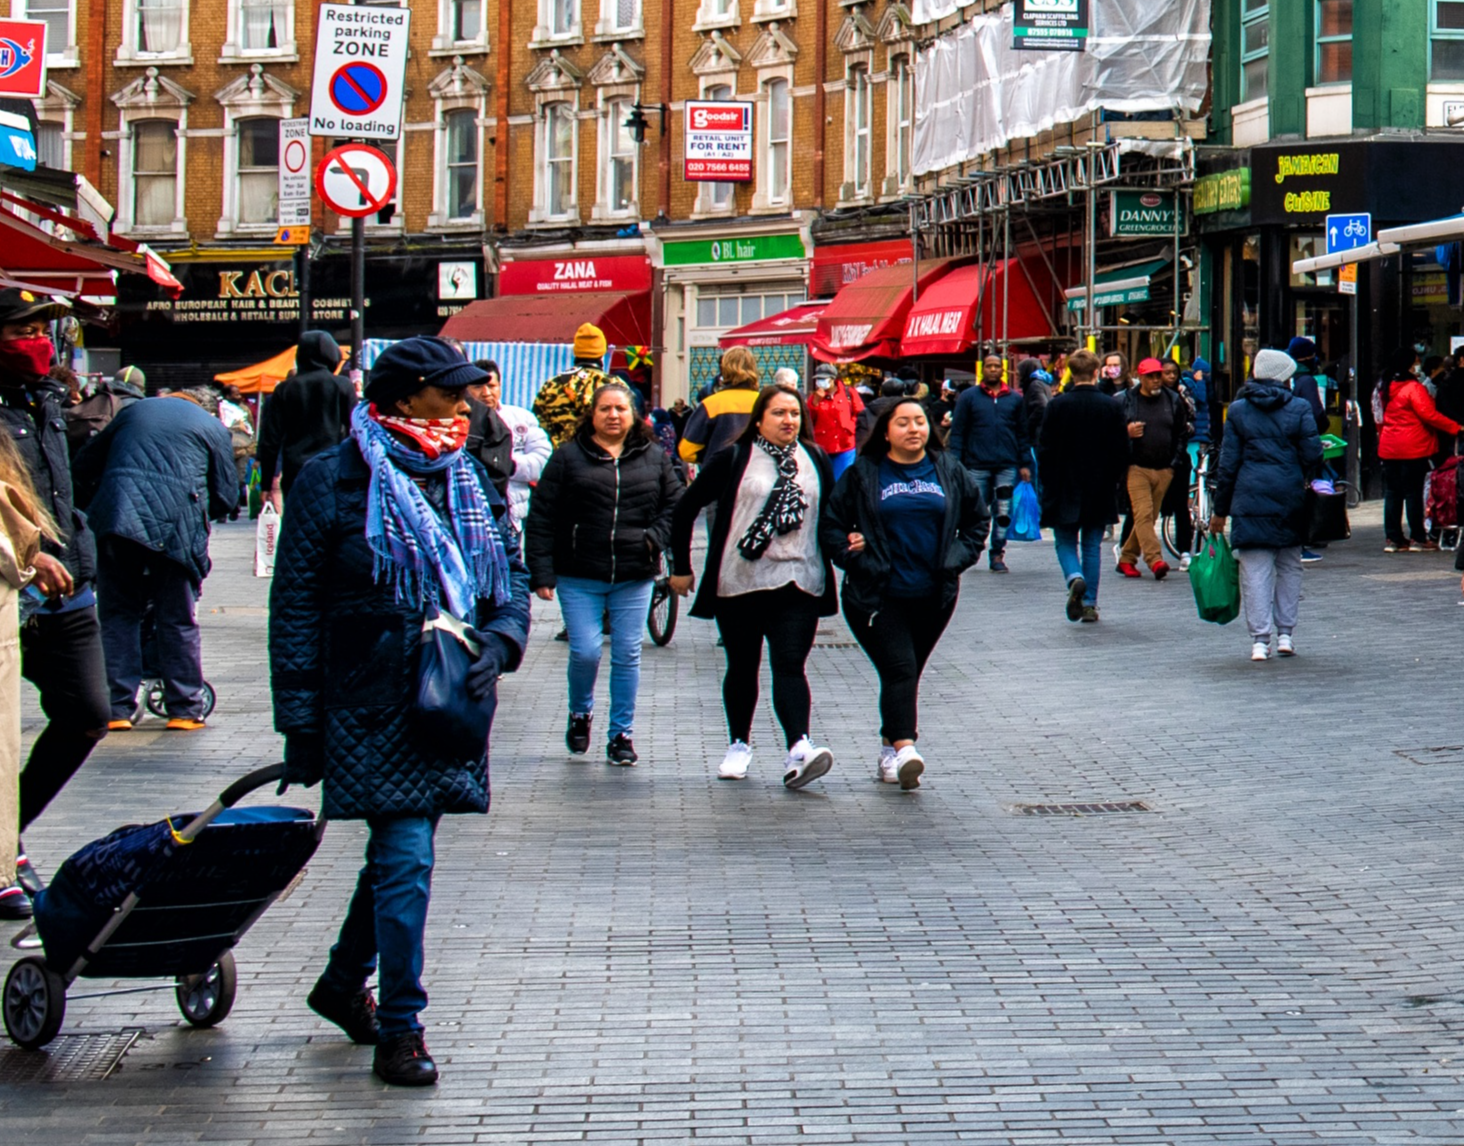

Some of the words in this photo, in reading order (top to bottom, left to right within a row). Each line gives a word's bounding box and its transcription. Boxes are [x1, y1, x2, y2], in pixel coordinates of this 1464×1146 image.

[326, 9, 404, 25] Restricted
[335, 26, 391, 41] parking
[333, 40, 389, 57] ZONE
[314, 117, 335, 130] No
[341, 118, 395, 135] loading
[285, 128, 305, 138] ZONE
[690, 142, 713, 150] FOR
[717, 143, 747, 151] RENT
[688, 163, 704, 171] 020
[1119, 223, 1183, 232] GREENGROCES
[722, 242, 735, 258] BL
[736, 241, 756, 258] hair
[554, 261, 596, 280] ZANA
[560, 281, 577, 289] HALAL
[146, 301, 171, 310] AFRO
[175, 300, 227, 310] EUROPEAN
[269, 299, 300, 308] BEAUT
[173, 312, 229, 321] WHOLESALE
[313, 310, 344, 319] STORE
[265, 523, 275, 556] Iceland
